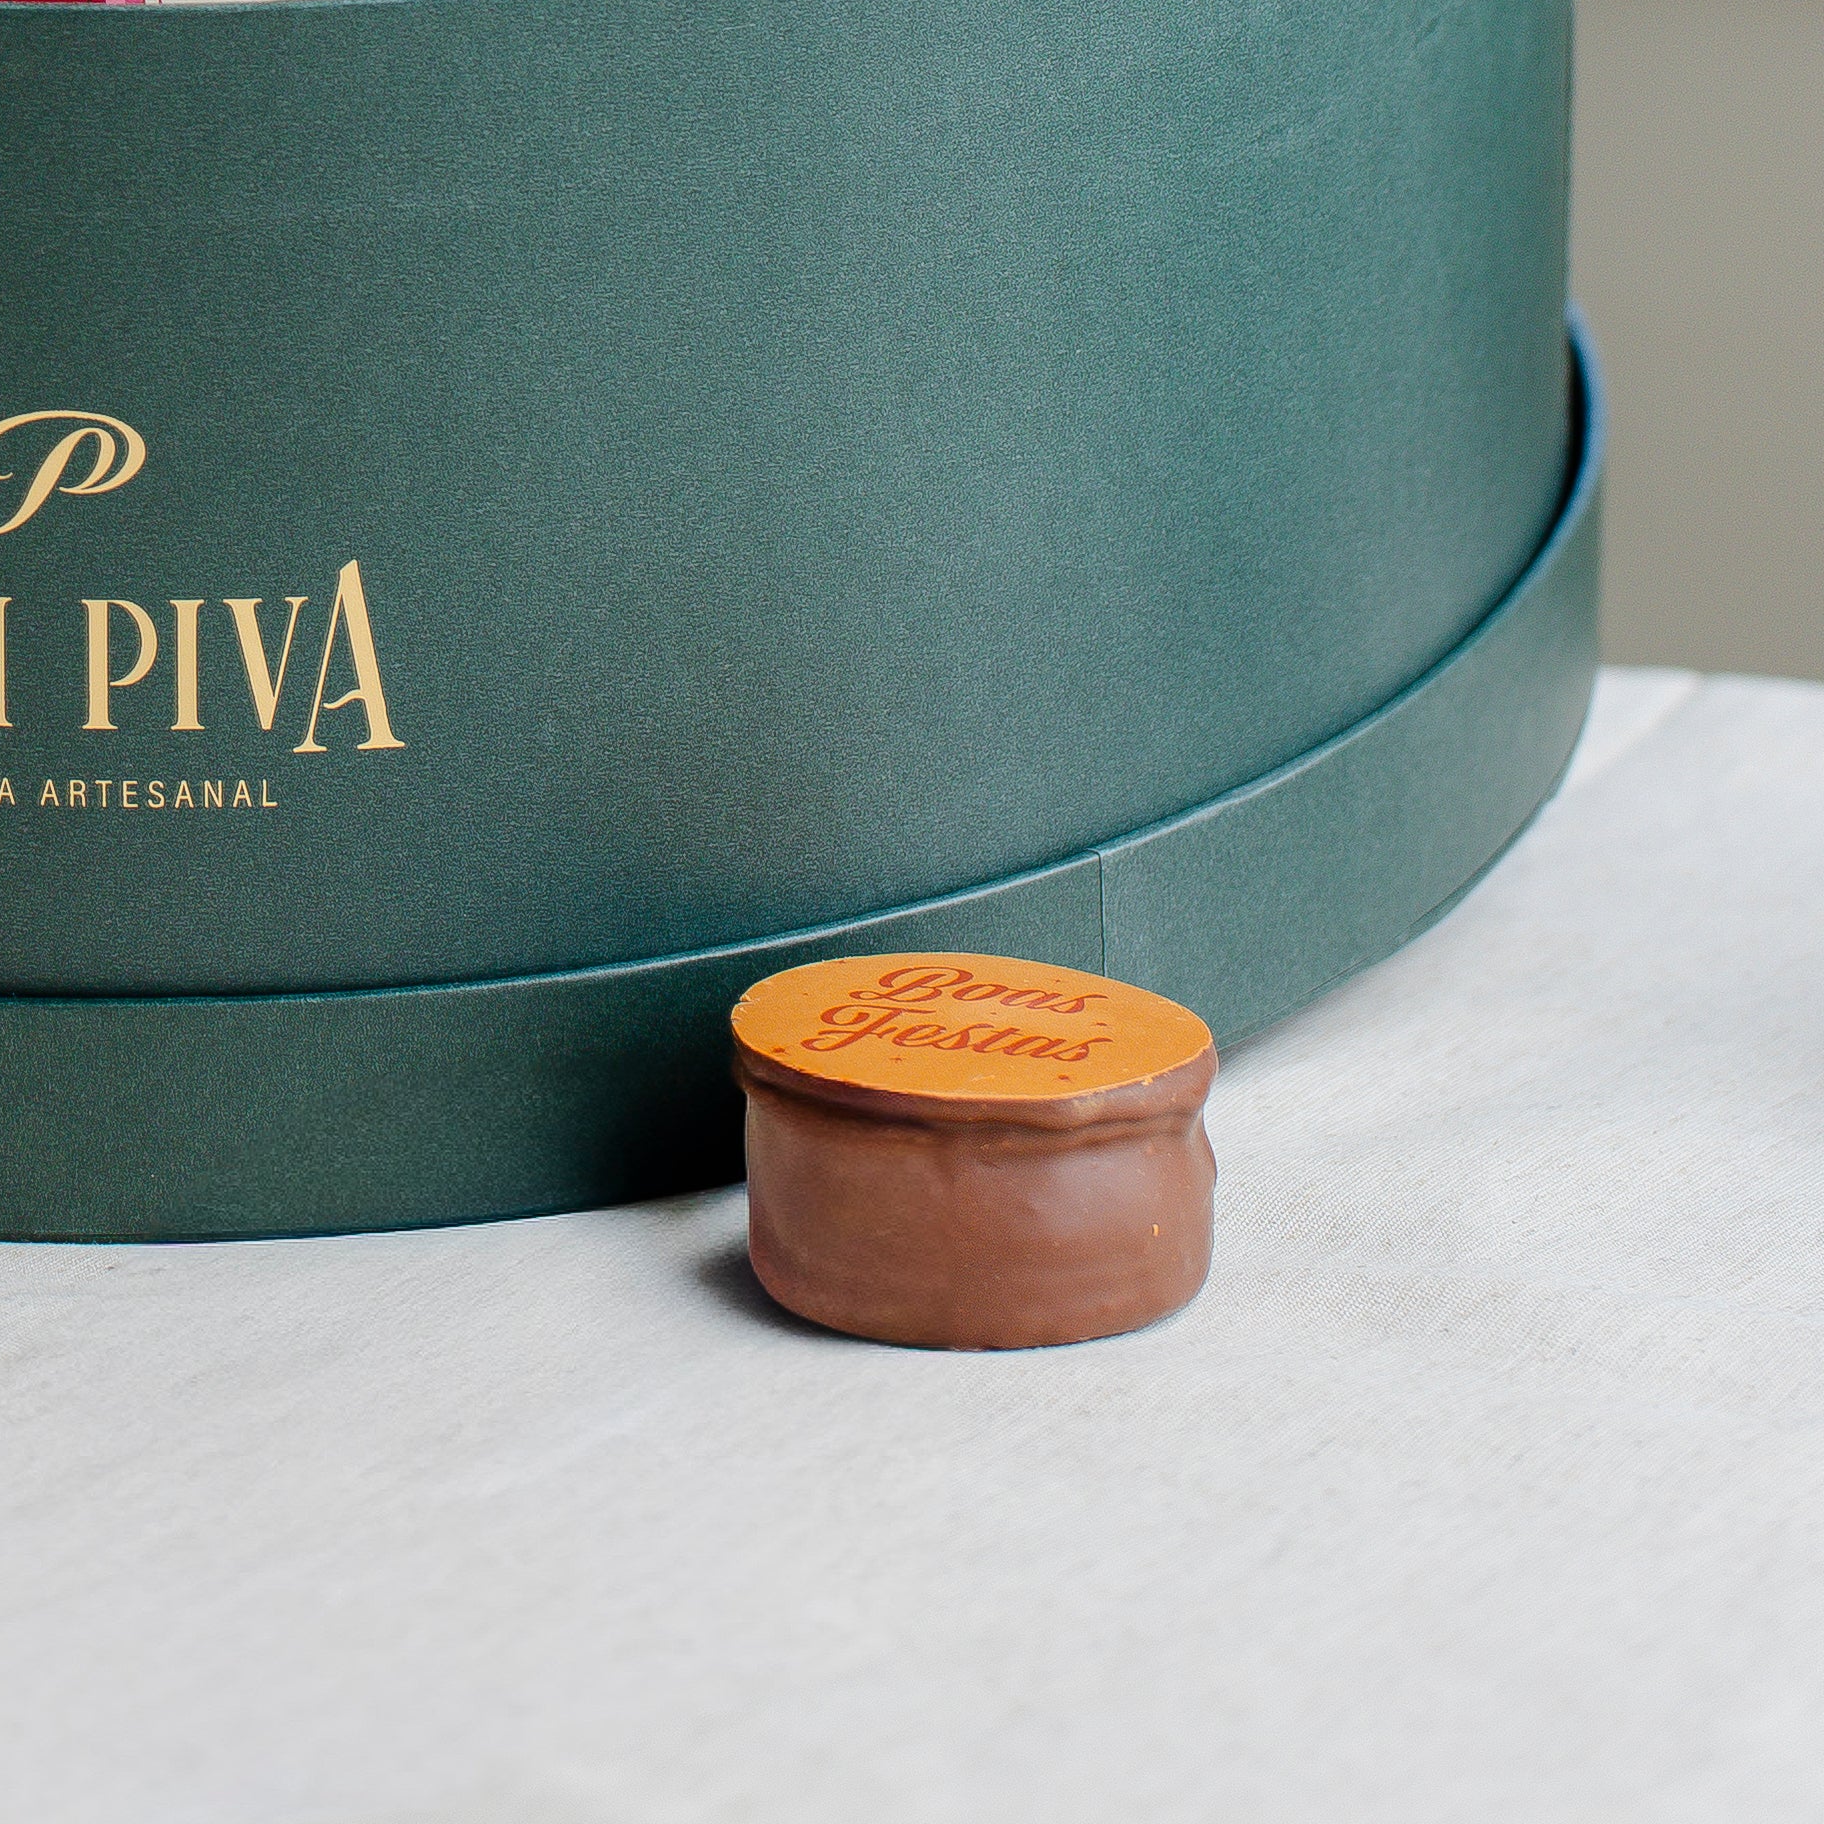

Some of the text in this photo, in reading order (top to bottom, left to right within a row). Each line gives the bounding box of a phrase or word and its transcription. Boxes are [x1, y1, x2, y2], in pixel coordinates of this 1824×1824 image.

[81, 558, 406, 754] PIVA
[40, 778, 280, 809] ARTESANAL
[848, 965, 1109, 1014] Boas
[800, 1003, 1114, 1062] Festas
